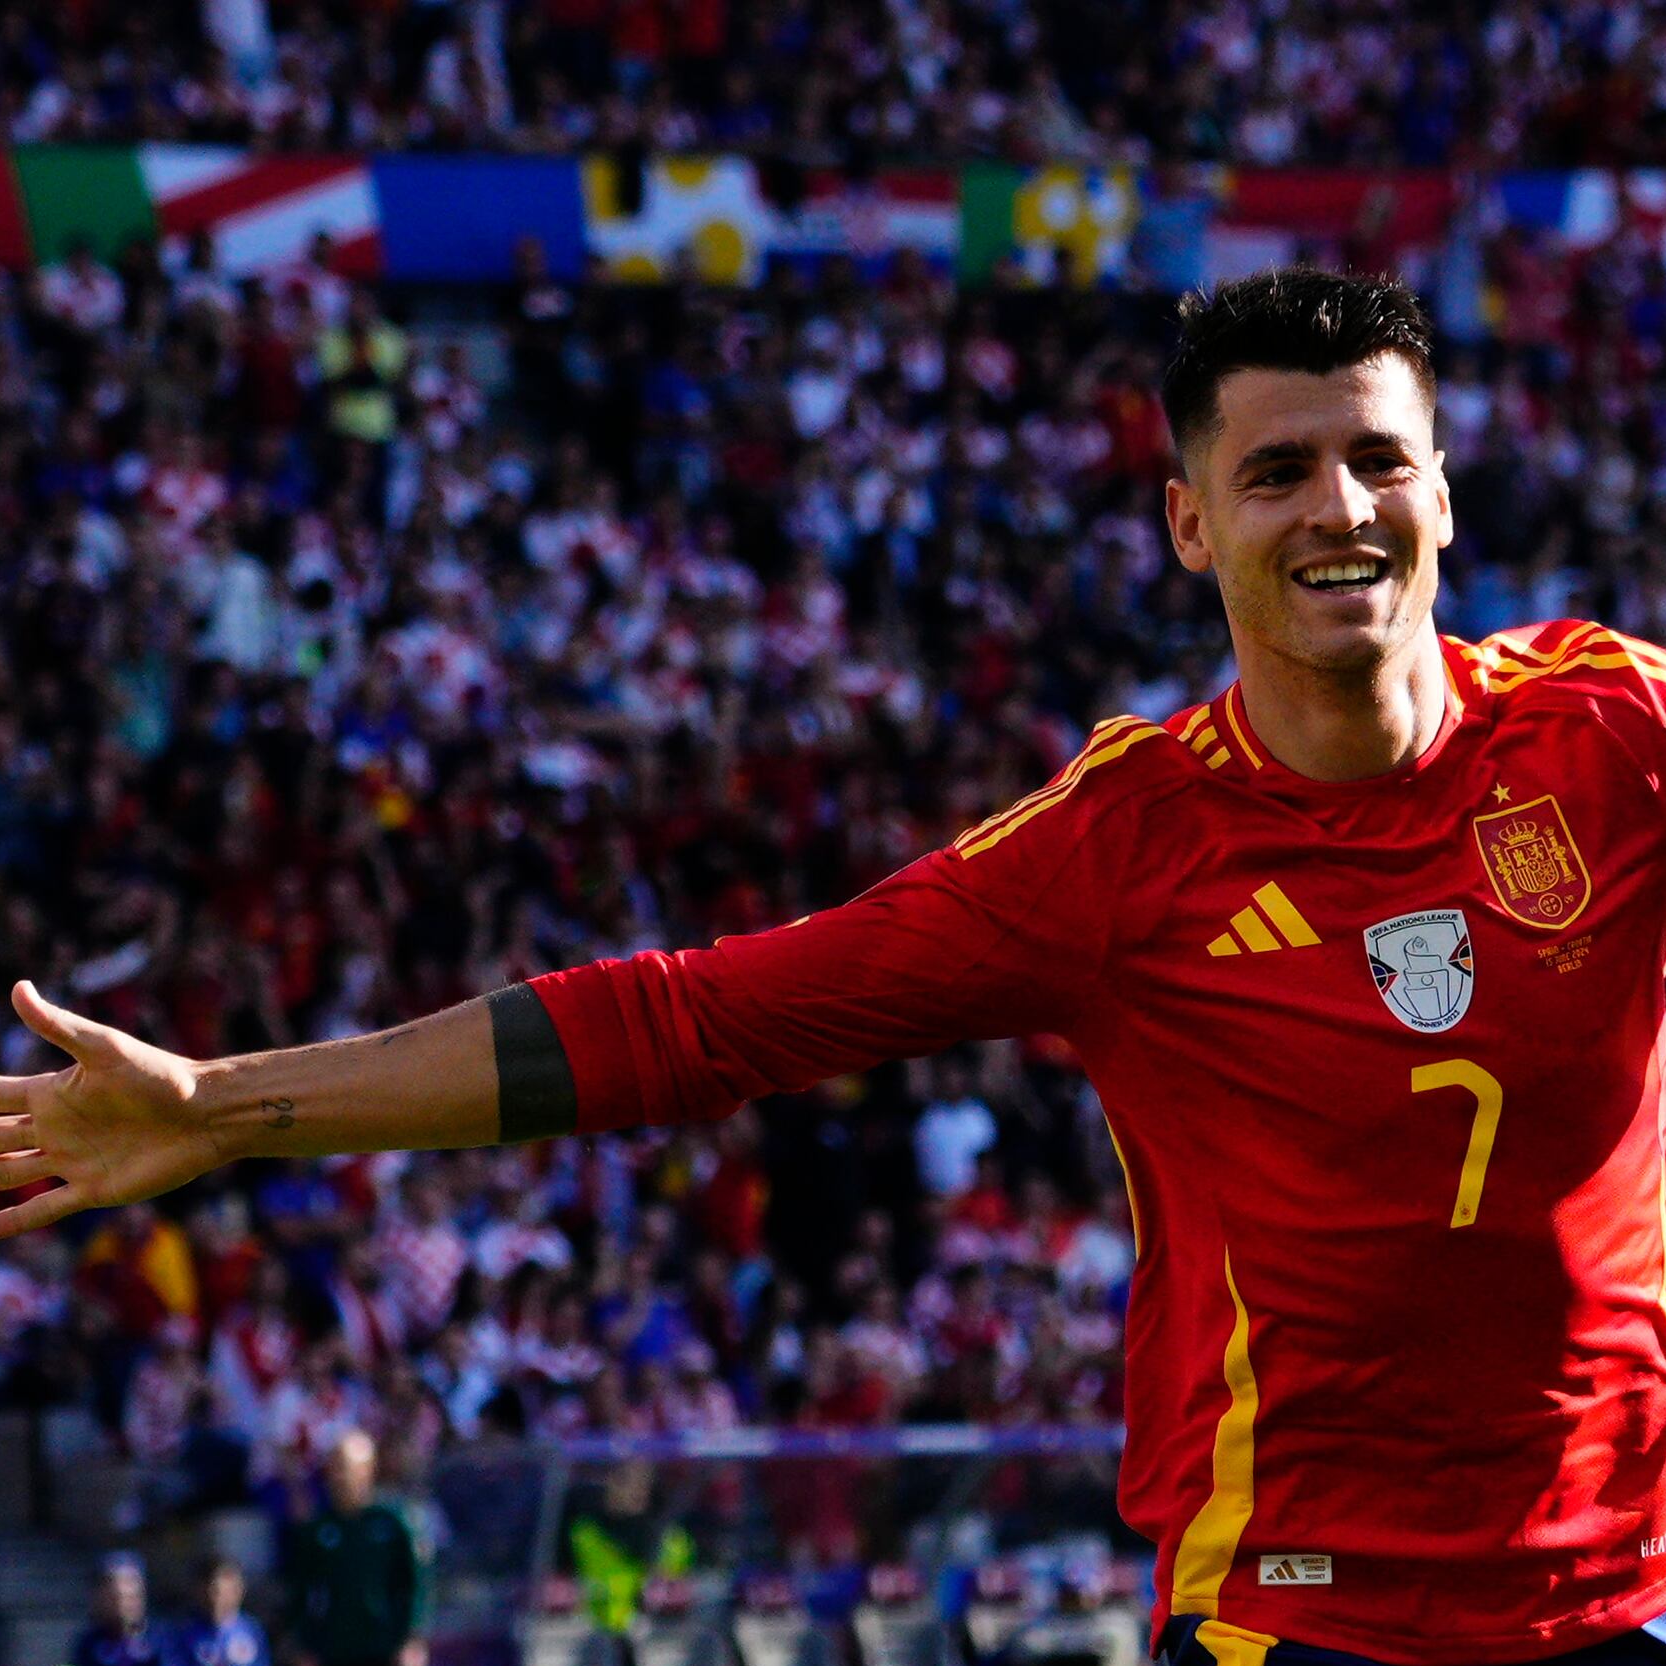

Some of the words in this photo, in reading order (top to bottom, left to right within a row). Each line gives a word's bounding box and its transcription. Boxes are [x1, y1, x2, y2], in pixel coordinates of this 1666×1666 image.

[1368, 925, 1390, 938] UEFA
[1390, 915, 1426, 930] NATIONS
[1426, 913, 1459, 921] LEAGUE
[1411, 1058, 1503, 1229] 7
